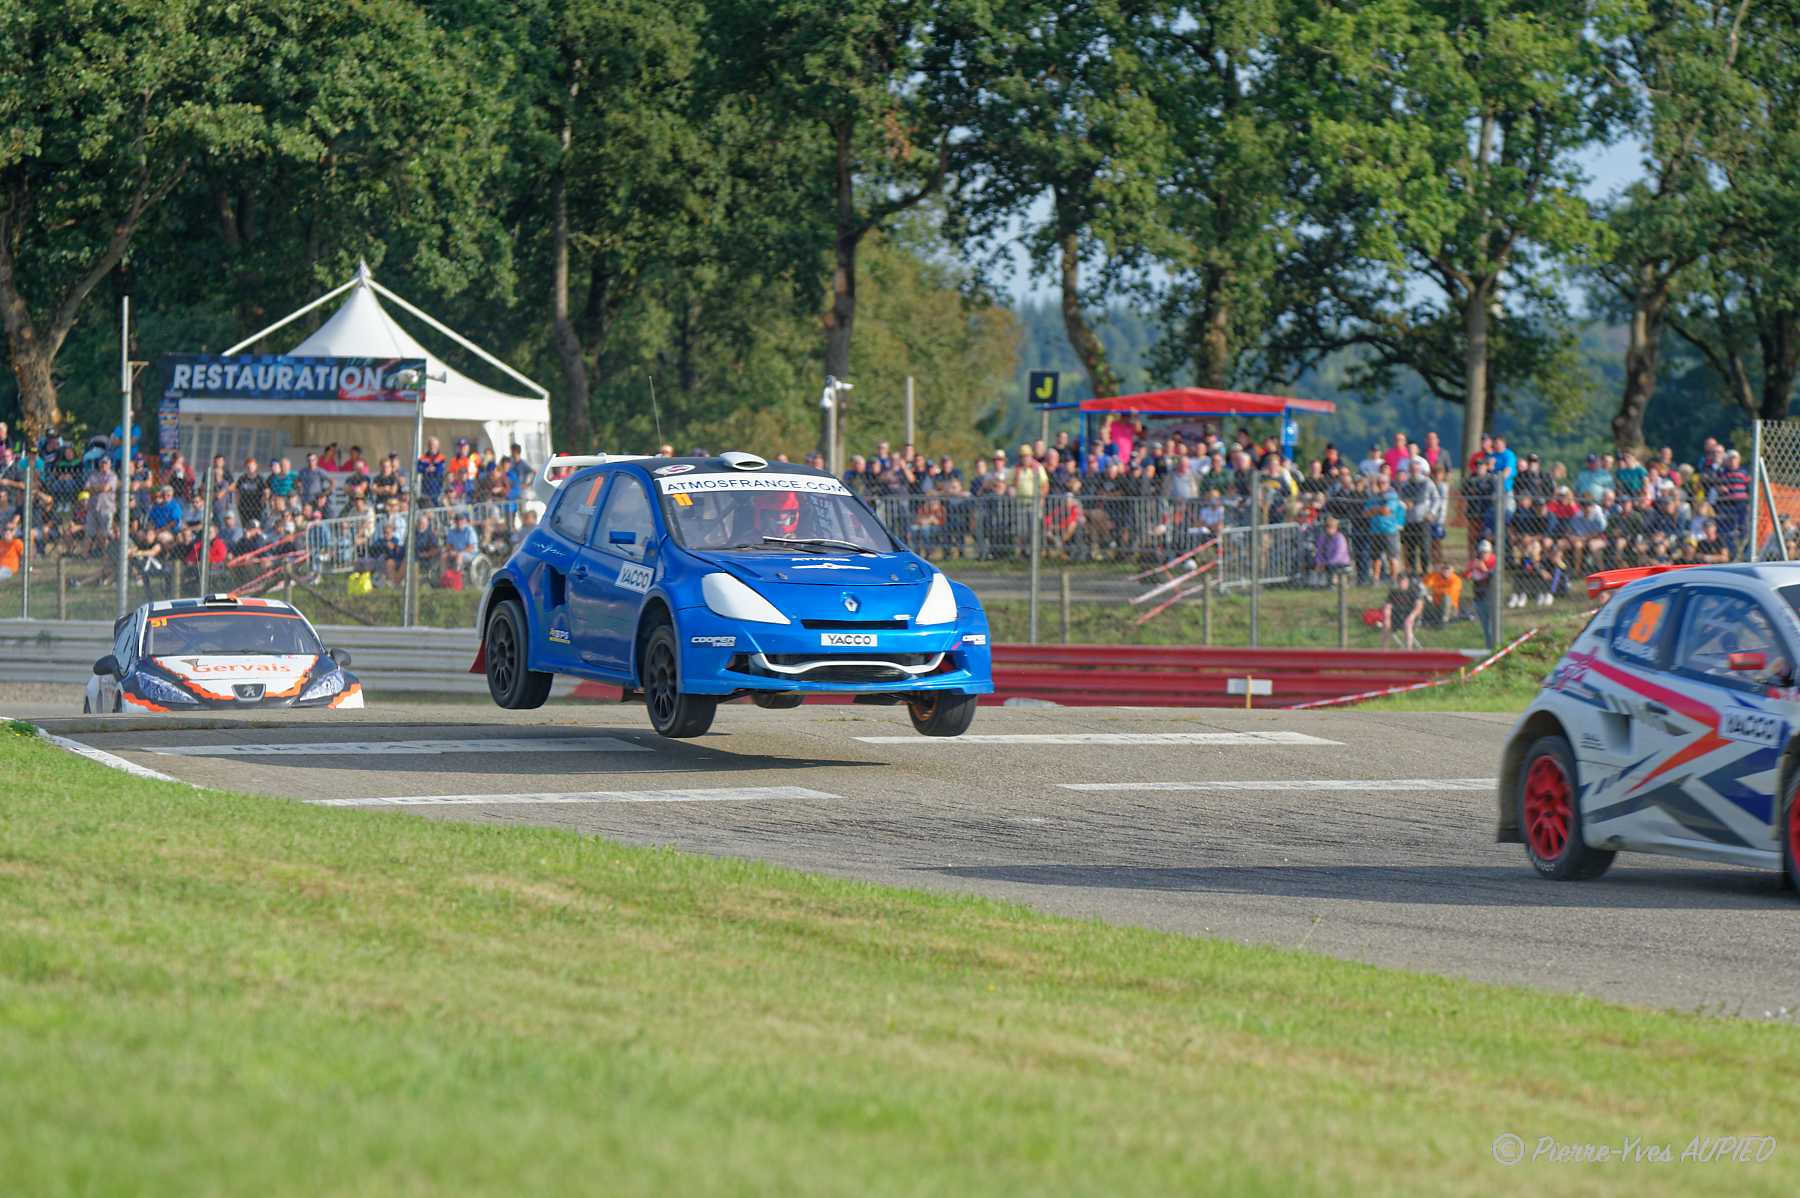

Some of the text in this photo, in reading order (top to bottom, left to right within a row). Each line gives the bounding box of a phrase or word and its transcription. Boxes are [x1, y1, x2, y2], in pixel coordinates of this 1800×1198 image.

[173, 363, 383, 391] RESTAURATION
[1035, 376, 1053, 399] J
[666, 479, 847, 493] ATMOSFRANCE.COM
[621, 566, 650, 589] YACCO
[827, 634, 872, 645] YACCO
[192, 663, 291, 673] Gervais
[1727, 712, 1776, 740] YACCO
